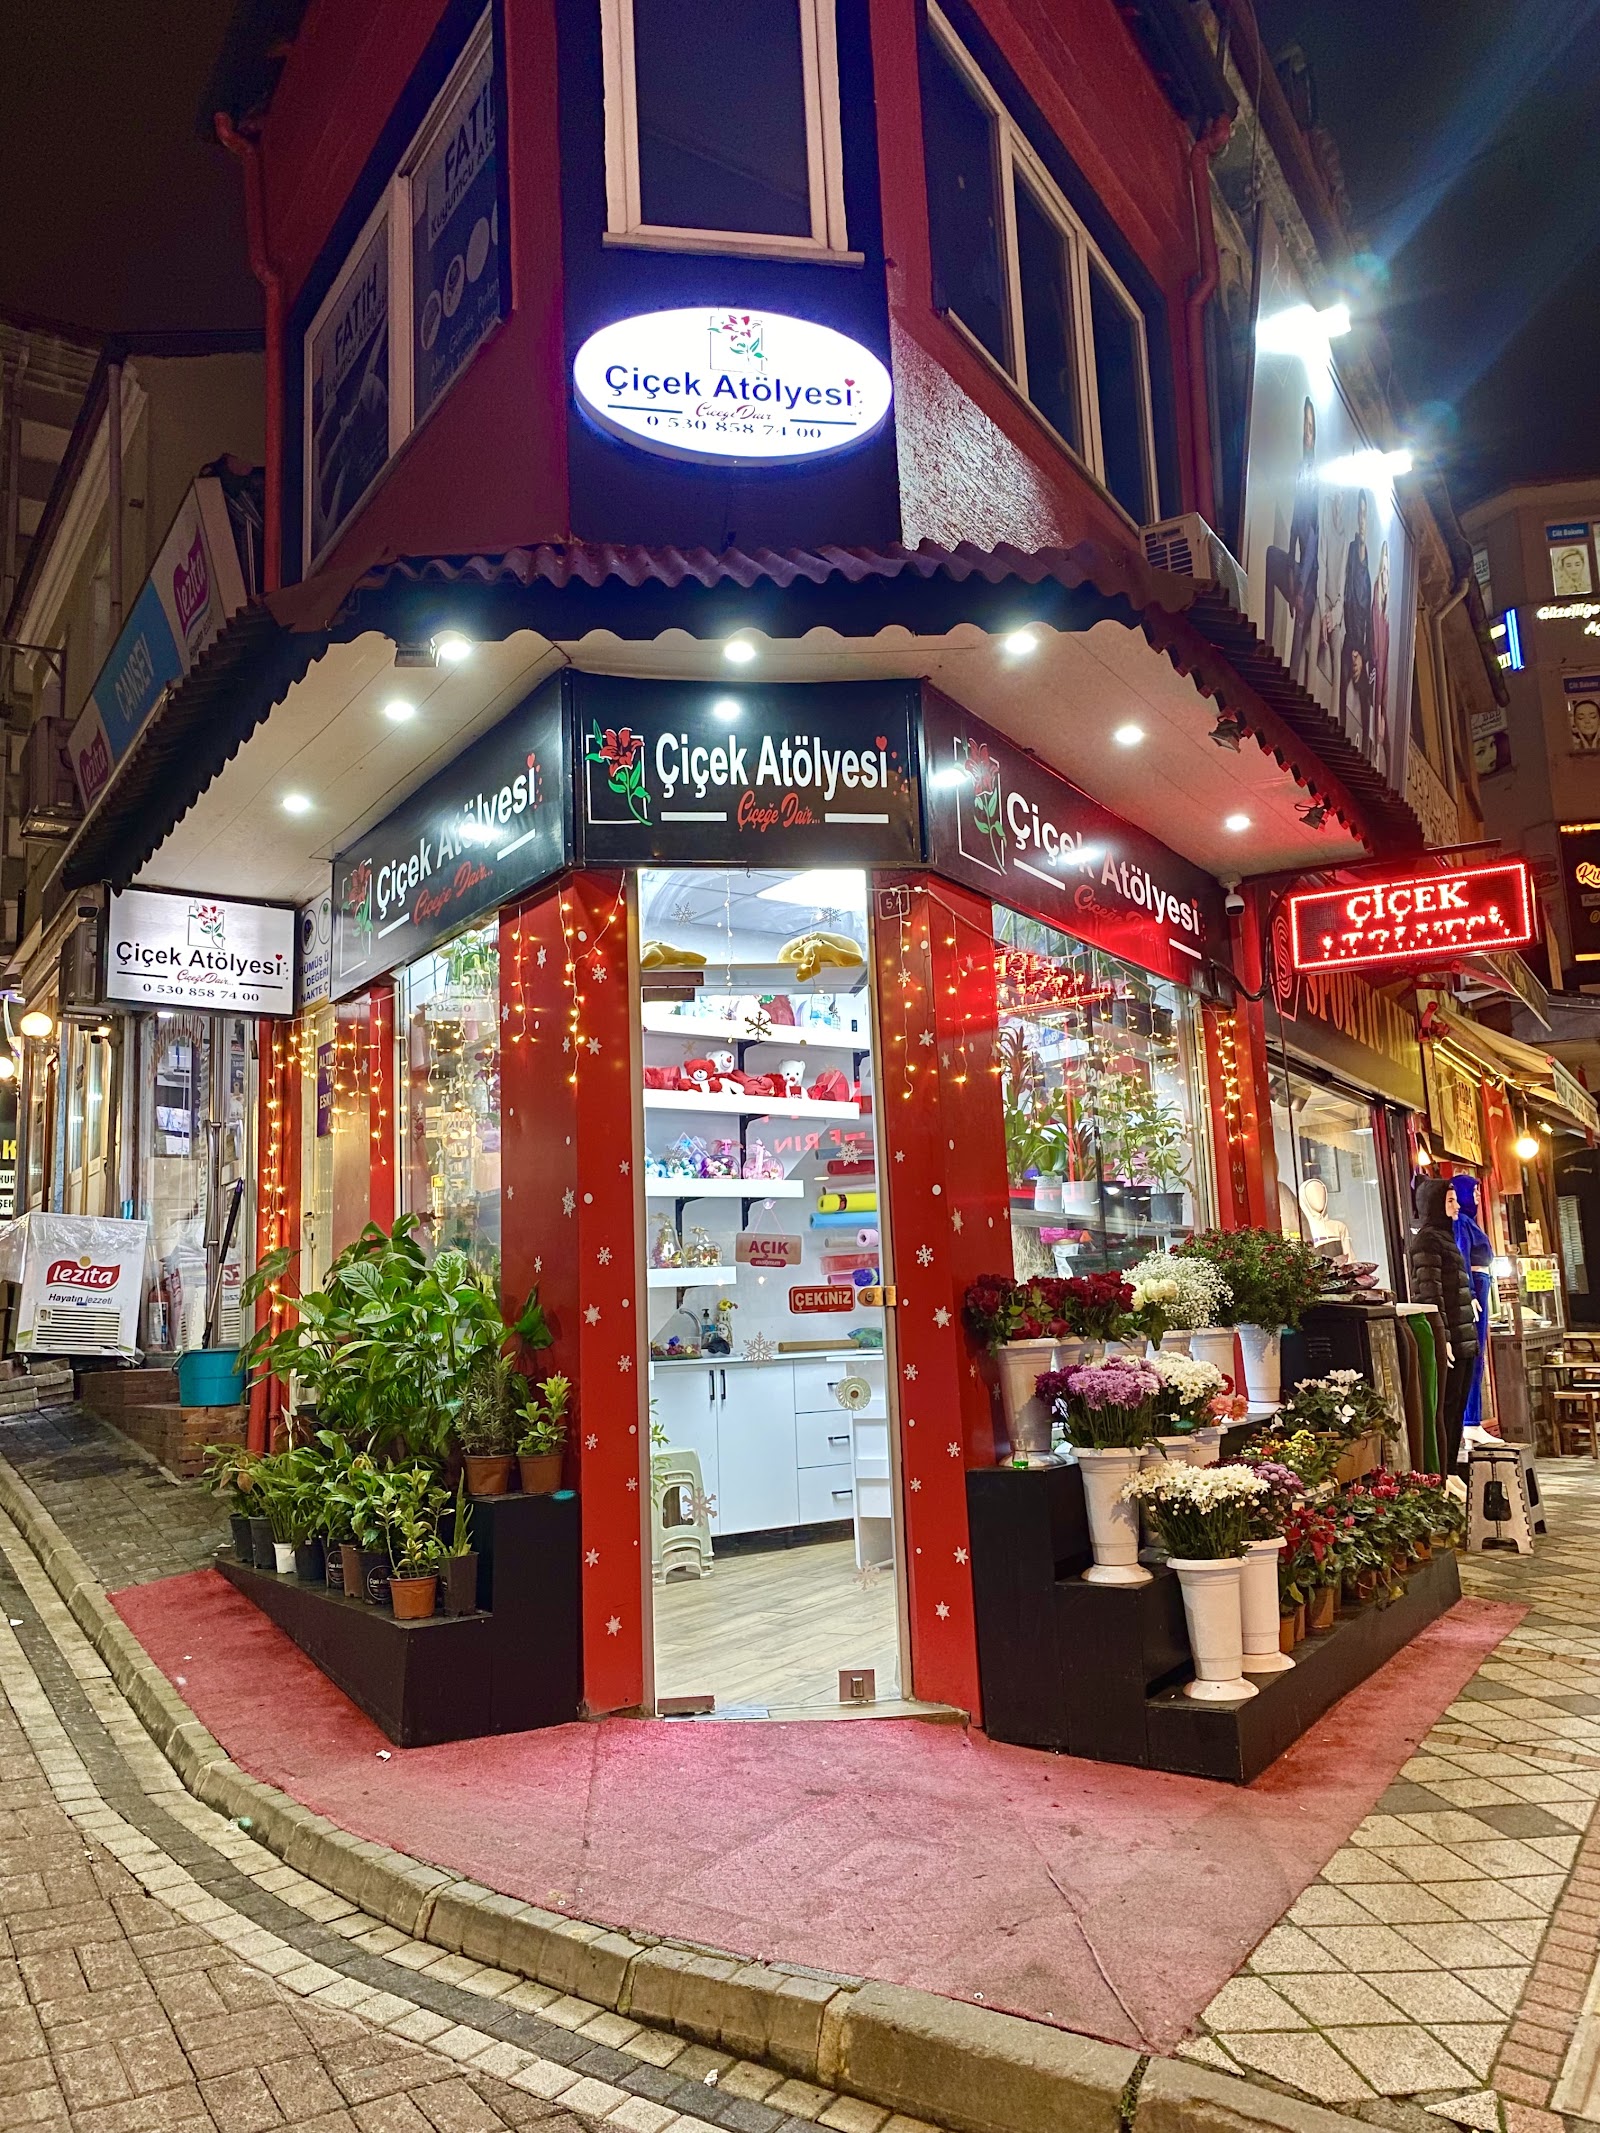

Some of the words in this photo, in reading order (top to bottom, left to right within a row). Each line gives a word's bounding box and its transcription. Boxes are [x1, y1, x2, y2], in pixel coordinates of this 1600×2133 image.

[605, 365, 702, 399] Çiçek
[712, 374, 854, 410] Atölyesi
[646, 416, 659, 426] 0
[668, 417, 707, 431] 530
[715, 421, 754, 434] 858
[796, 427, 821, 438] 00
[176, 549, 206, 624] lezita
[115, 631, 154, 722] CANSEV
[655, 732, 749, 798] Çiçek
[756, 735, 888, 801] Atölyesi
[377, 838, 432, 920] Çiçek
[436, 760, 537, 869] Atölyesi
[1006, 791, 1095, 879] Çiçek
[1100, 850, 1200, 936] Atölyesi
[1346, 881, 1469, 928] ÇİÇEK
[116, 941, 182, 967] Çiçek
[188, 949, 282, 976] Atölyesi
[298, 955, 323, 977] GÜMÜŞ
[143, 983, 152, 992] 0
[156, 985, 183, 995] 530
[188, 988, 215, 998] 858
[220, 990, 237, 1000] 74
[242, 993, 259, 1002] 00
[748, 1240, 790, 1258] AÇIK
[53, 1264, 113, 1285] lezita
[48, 1293, 83, 1304] Hayatın
[84, 1294, 113, 1305] lezzeti
[794, 1290, 852, 1311] ÇEKİNİZ
